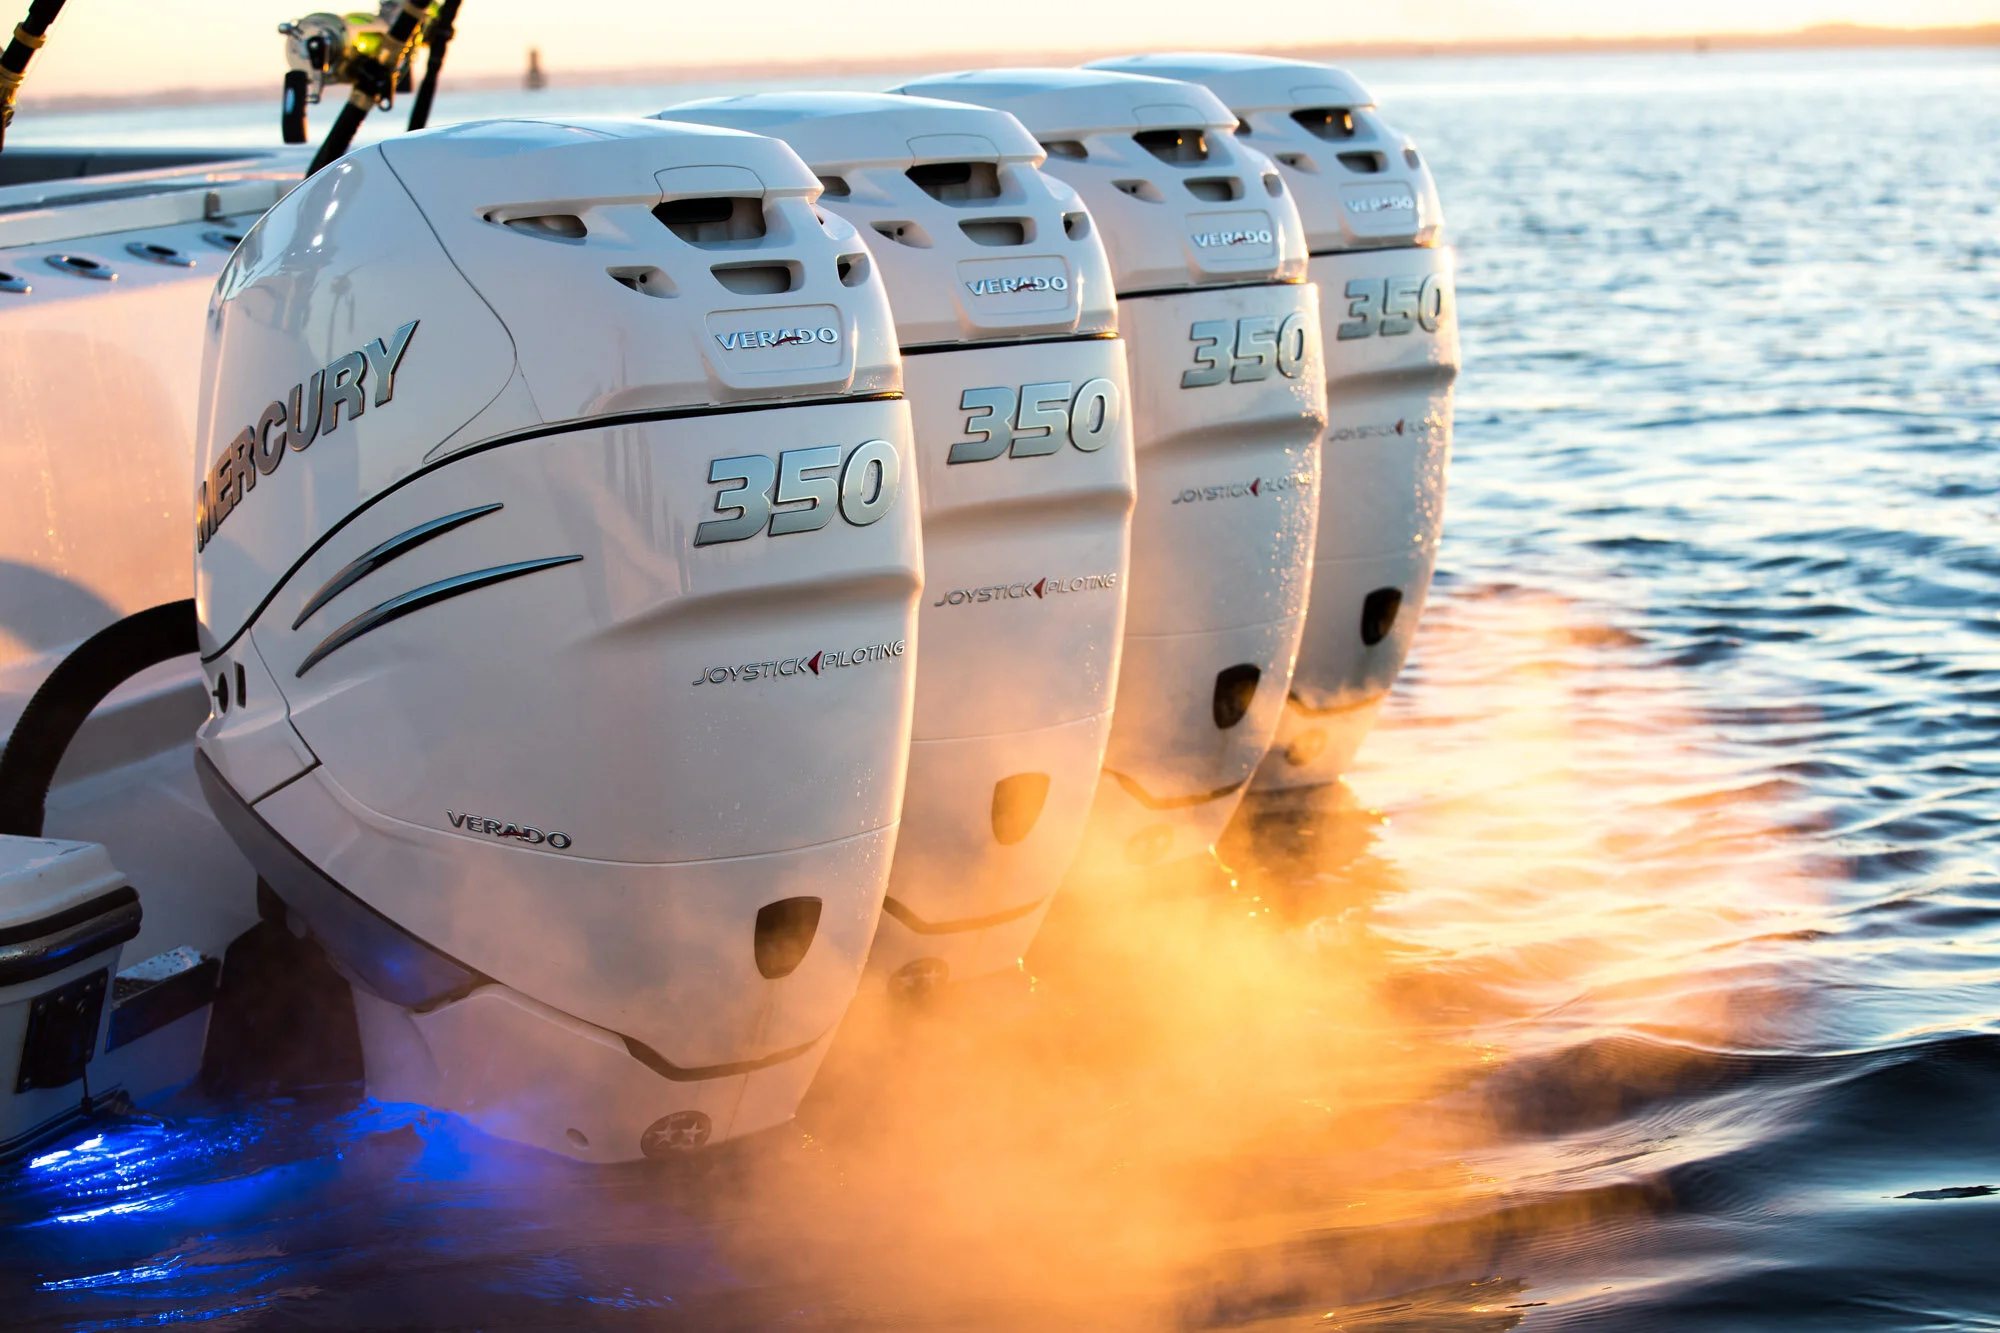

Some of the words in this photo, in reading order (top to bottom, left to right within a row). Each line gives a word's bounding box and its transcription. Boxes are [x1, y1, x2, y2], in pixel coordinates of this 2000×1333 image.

[1192, 229, 1273, 249] VERADO
[965, 275, 1068, 296] VERADO
[1337, 273, 1444, 342] 350
[715, 327, 839, 350] VERADO
[1180, 311, 1311, 389] 350
[196, 319, 420, 554] MERCURY
[947, 377, 1120, 465] 350
[693, 438, 900, 547] 350
[934, 582, 1033, 607] JOYSTICK
[1044, 572, 1116, 595] PILOTING
[692, 656, 808, 686] JOYSTICK
[821, 639, 905, 670] PILOTING
[446, 808, 572, 849] VERADO
